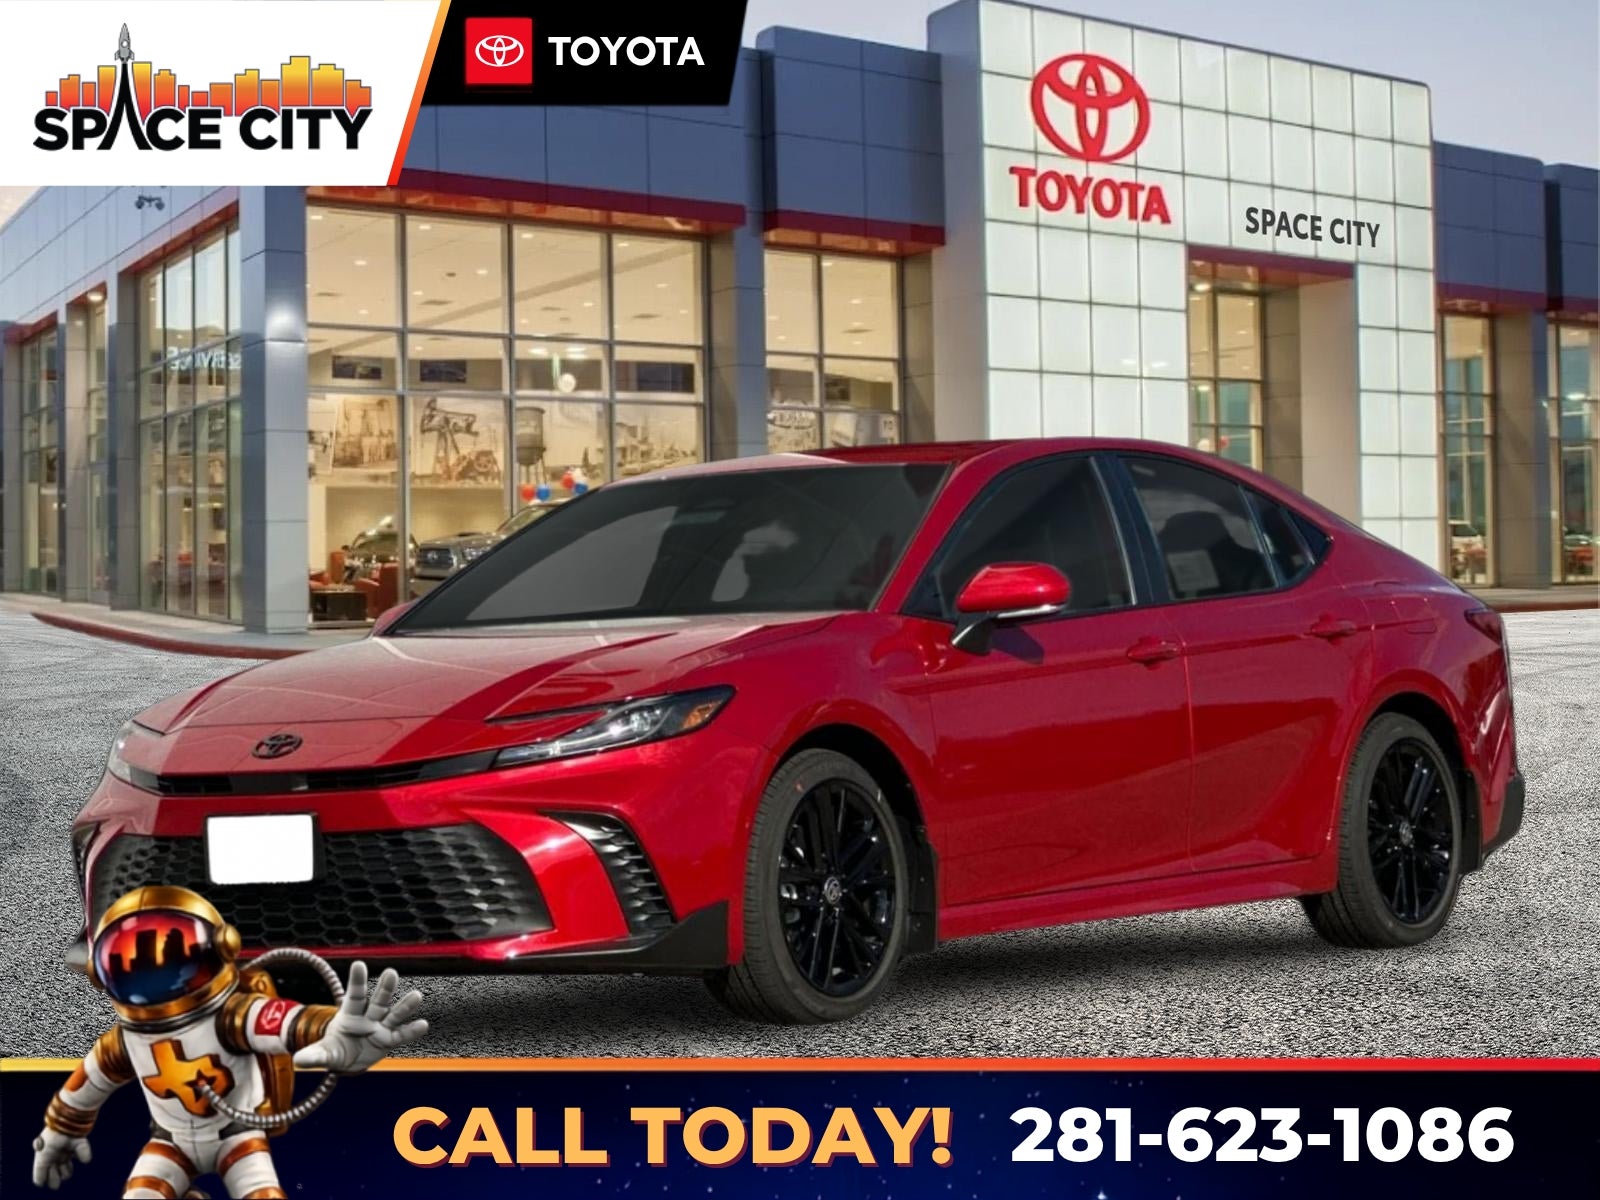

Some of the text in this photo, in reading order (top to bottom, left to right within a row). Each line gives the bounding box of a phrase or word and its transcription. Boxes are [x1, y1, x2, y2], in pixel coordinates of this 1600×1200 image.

[1009, 166, 1171, 225] TOYOTA
[1245, 206, 1381, 249] SPACE CITY
